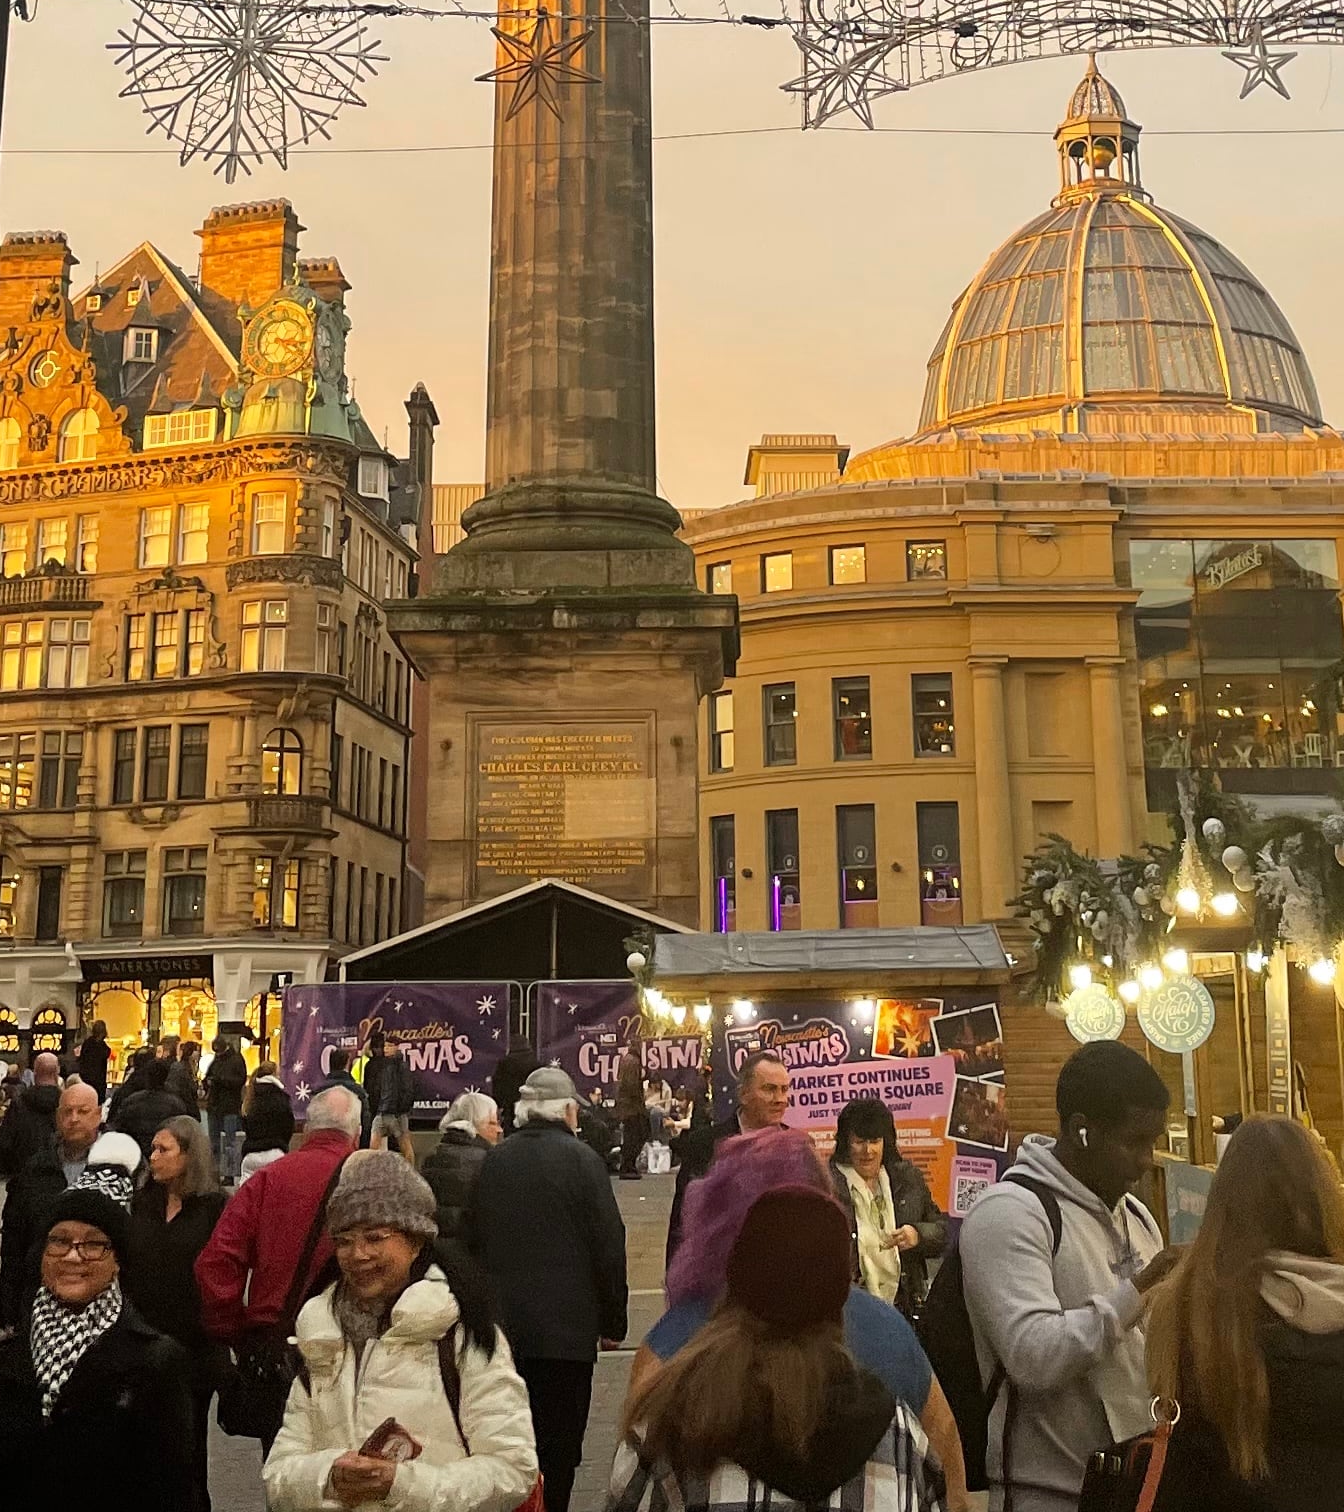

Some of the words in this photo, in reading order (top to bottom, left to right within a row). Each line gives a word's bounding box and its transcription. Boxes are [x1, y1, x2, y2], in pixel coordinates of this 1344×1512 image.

[479, 762, 540, 773] CHARLES
[543, 762, 580, 772] EARL
[582, 761, 620, 772] GREY
[99, 958, 201, 974] WATERSTONES
[358, 1016, 454, 1041] Nwcastle's
[320, 1035, 473, 1076] CTMAS
[578, 1038, 703, 1084] CHISTM
[848, 1067, 930, 1086] CONTINUES
[799, 1091, 828, 1106] OLD
[832, 1088, 880, 1103] ELDON
[884, 1082, 944, 1100] SQUARE
[808, 1109, 829, 1119] JUST
